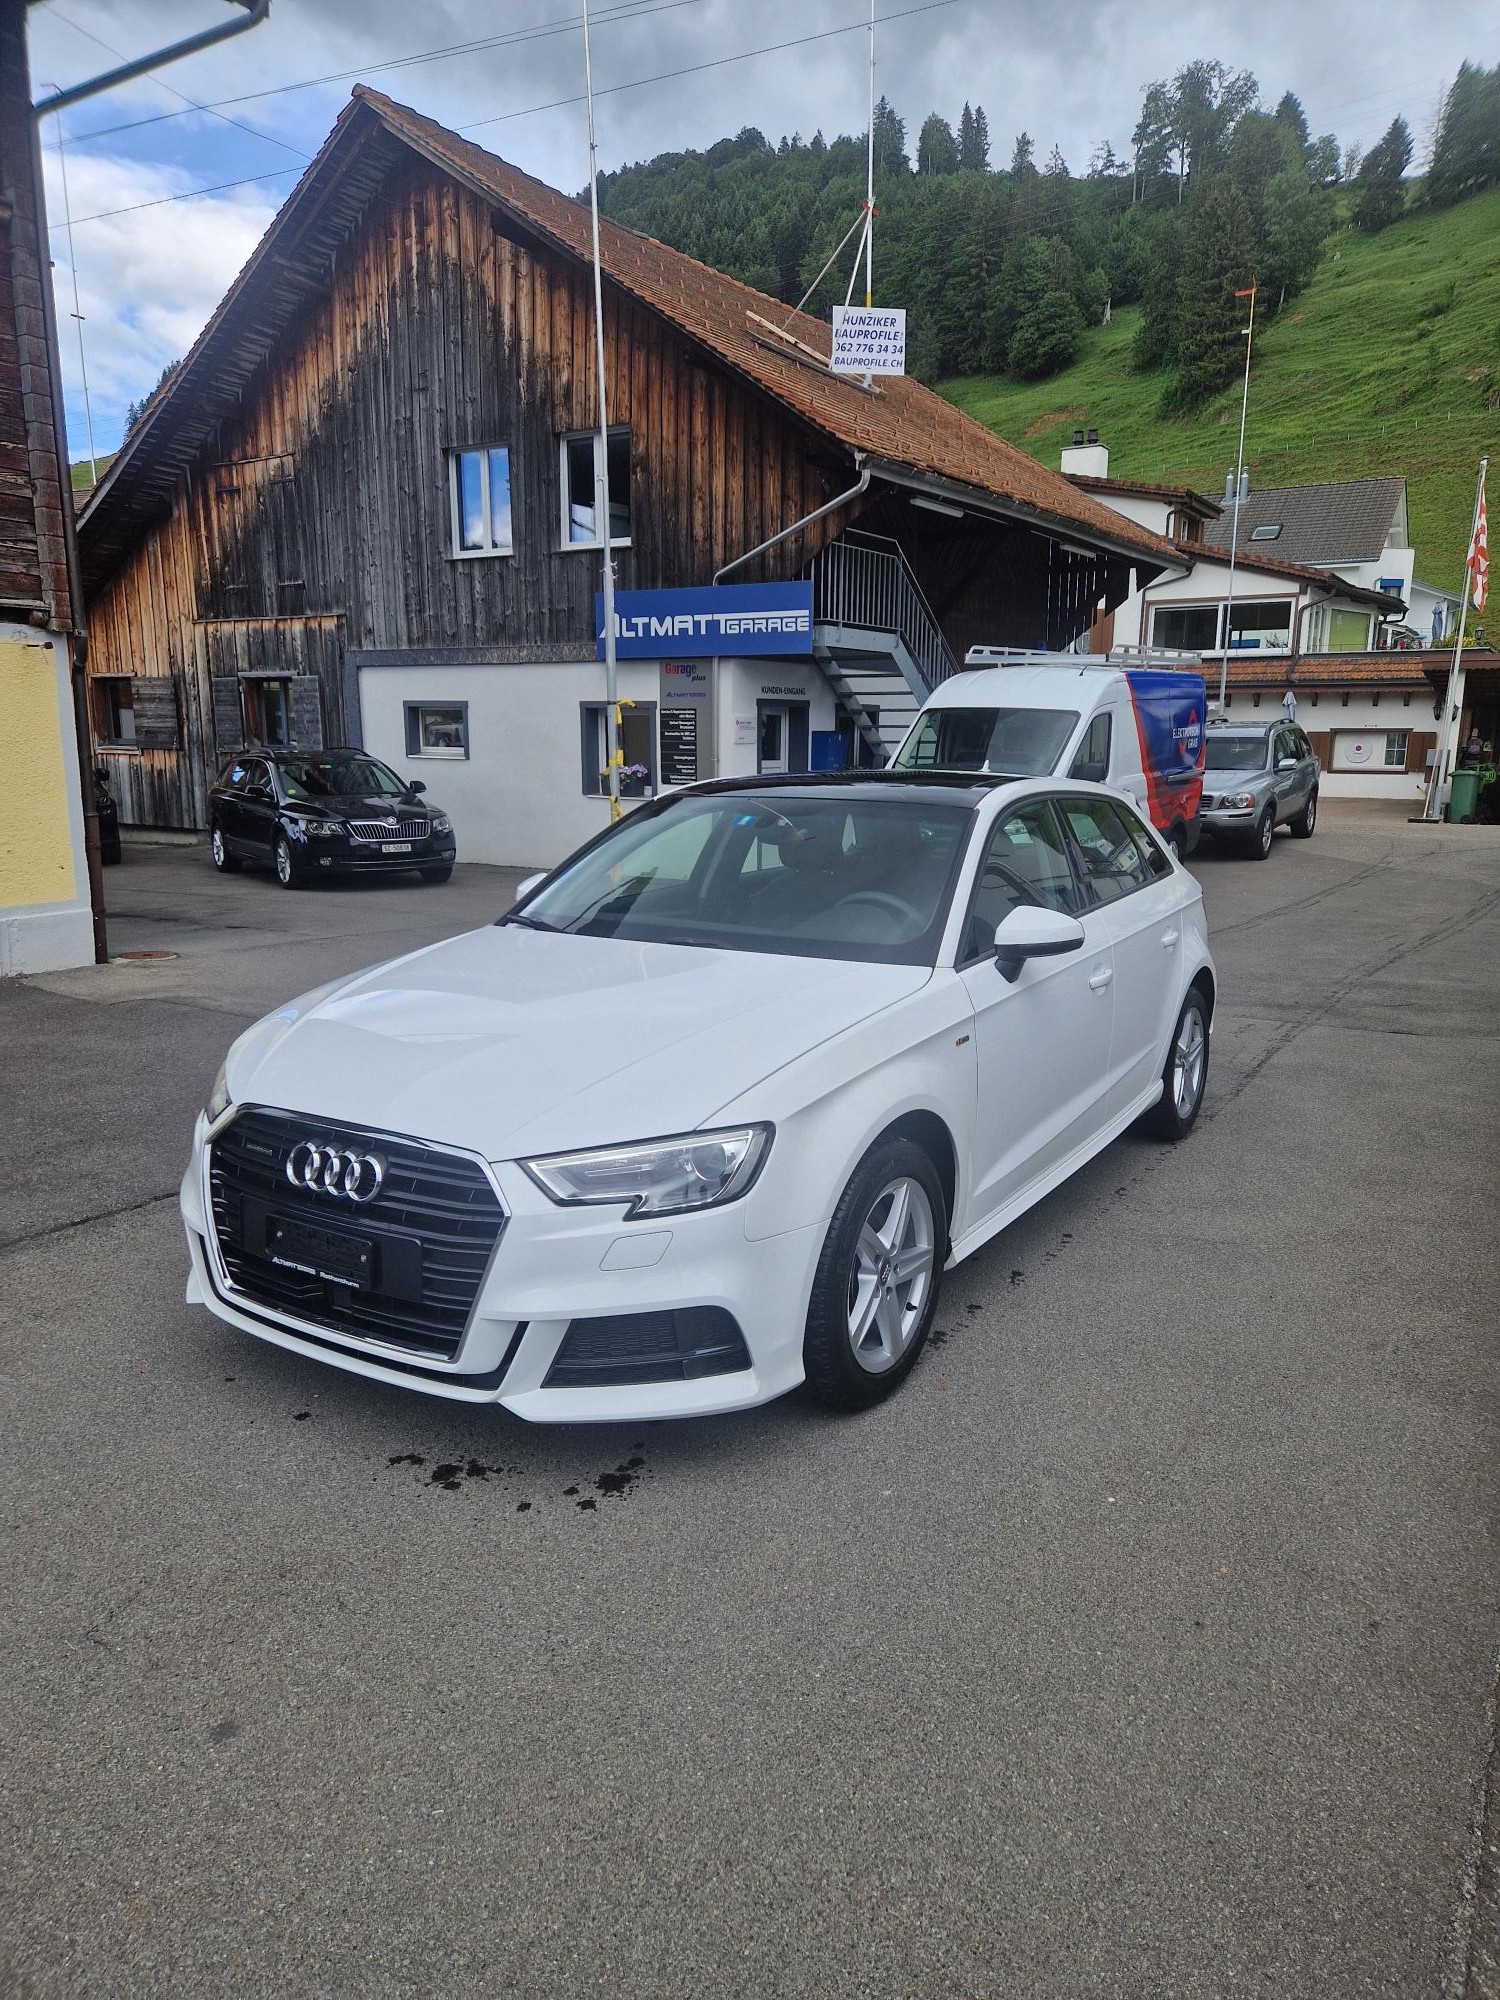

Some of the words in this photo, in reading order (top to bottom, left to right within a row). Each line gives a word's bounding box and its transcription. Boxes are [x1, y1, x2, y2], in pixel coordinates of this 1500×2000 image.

[842, 316, 897, 327] HUNZIKER
[856, 343, 874, 353] 776
[876, 345, 889, 354] 34
[891, 345, 904, 355] 34
[834, 356, 903, 368] BAUPROFILE.CH
[726, 616, 810, 635] GARAGE
[665, 663, 698, 677] Garage
[691, 674, 707, 682] plus
